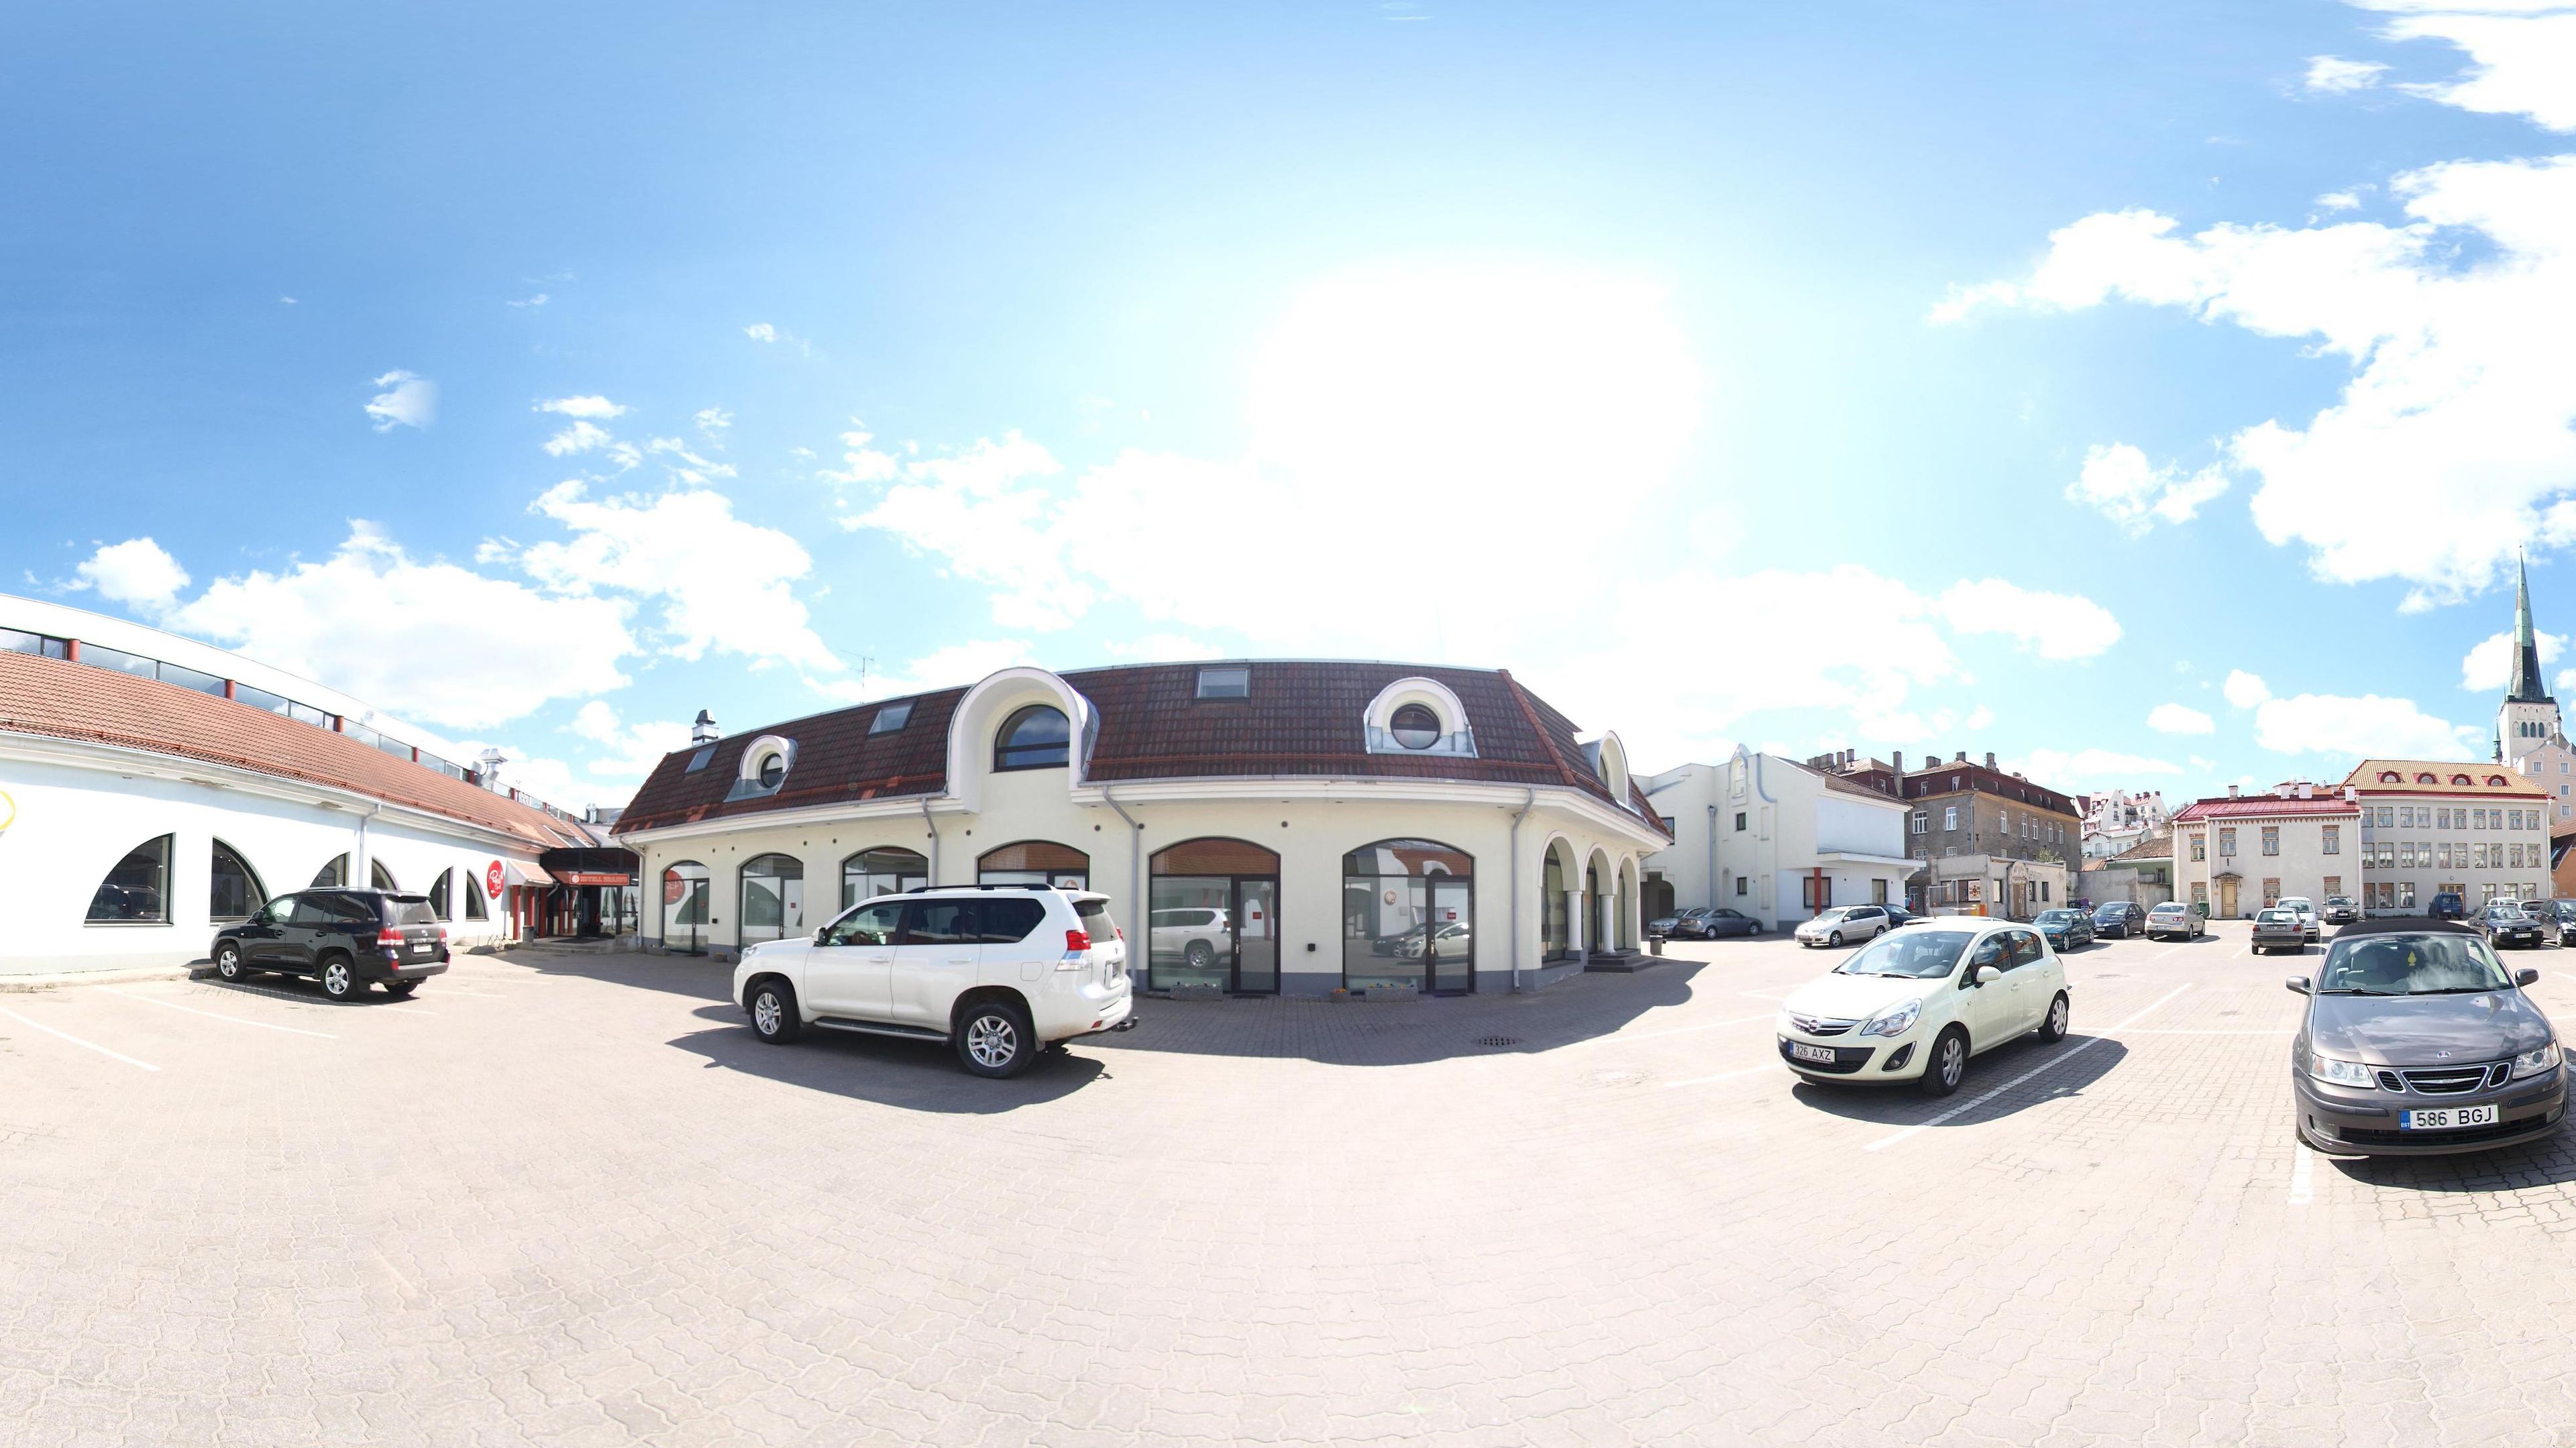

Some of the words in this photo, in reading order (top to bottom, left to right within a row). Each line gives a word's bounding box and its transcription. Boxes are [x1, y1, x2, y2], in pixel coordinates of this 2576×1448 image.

[1795, 1045, 1808, 1056] 326
[1812, 1048, 1831, 1060] AXZ
[2416, 1111, 2447, 1127] 586
[2459, 1107, 2491, 1125] BGJ
